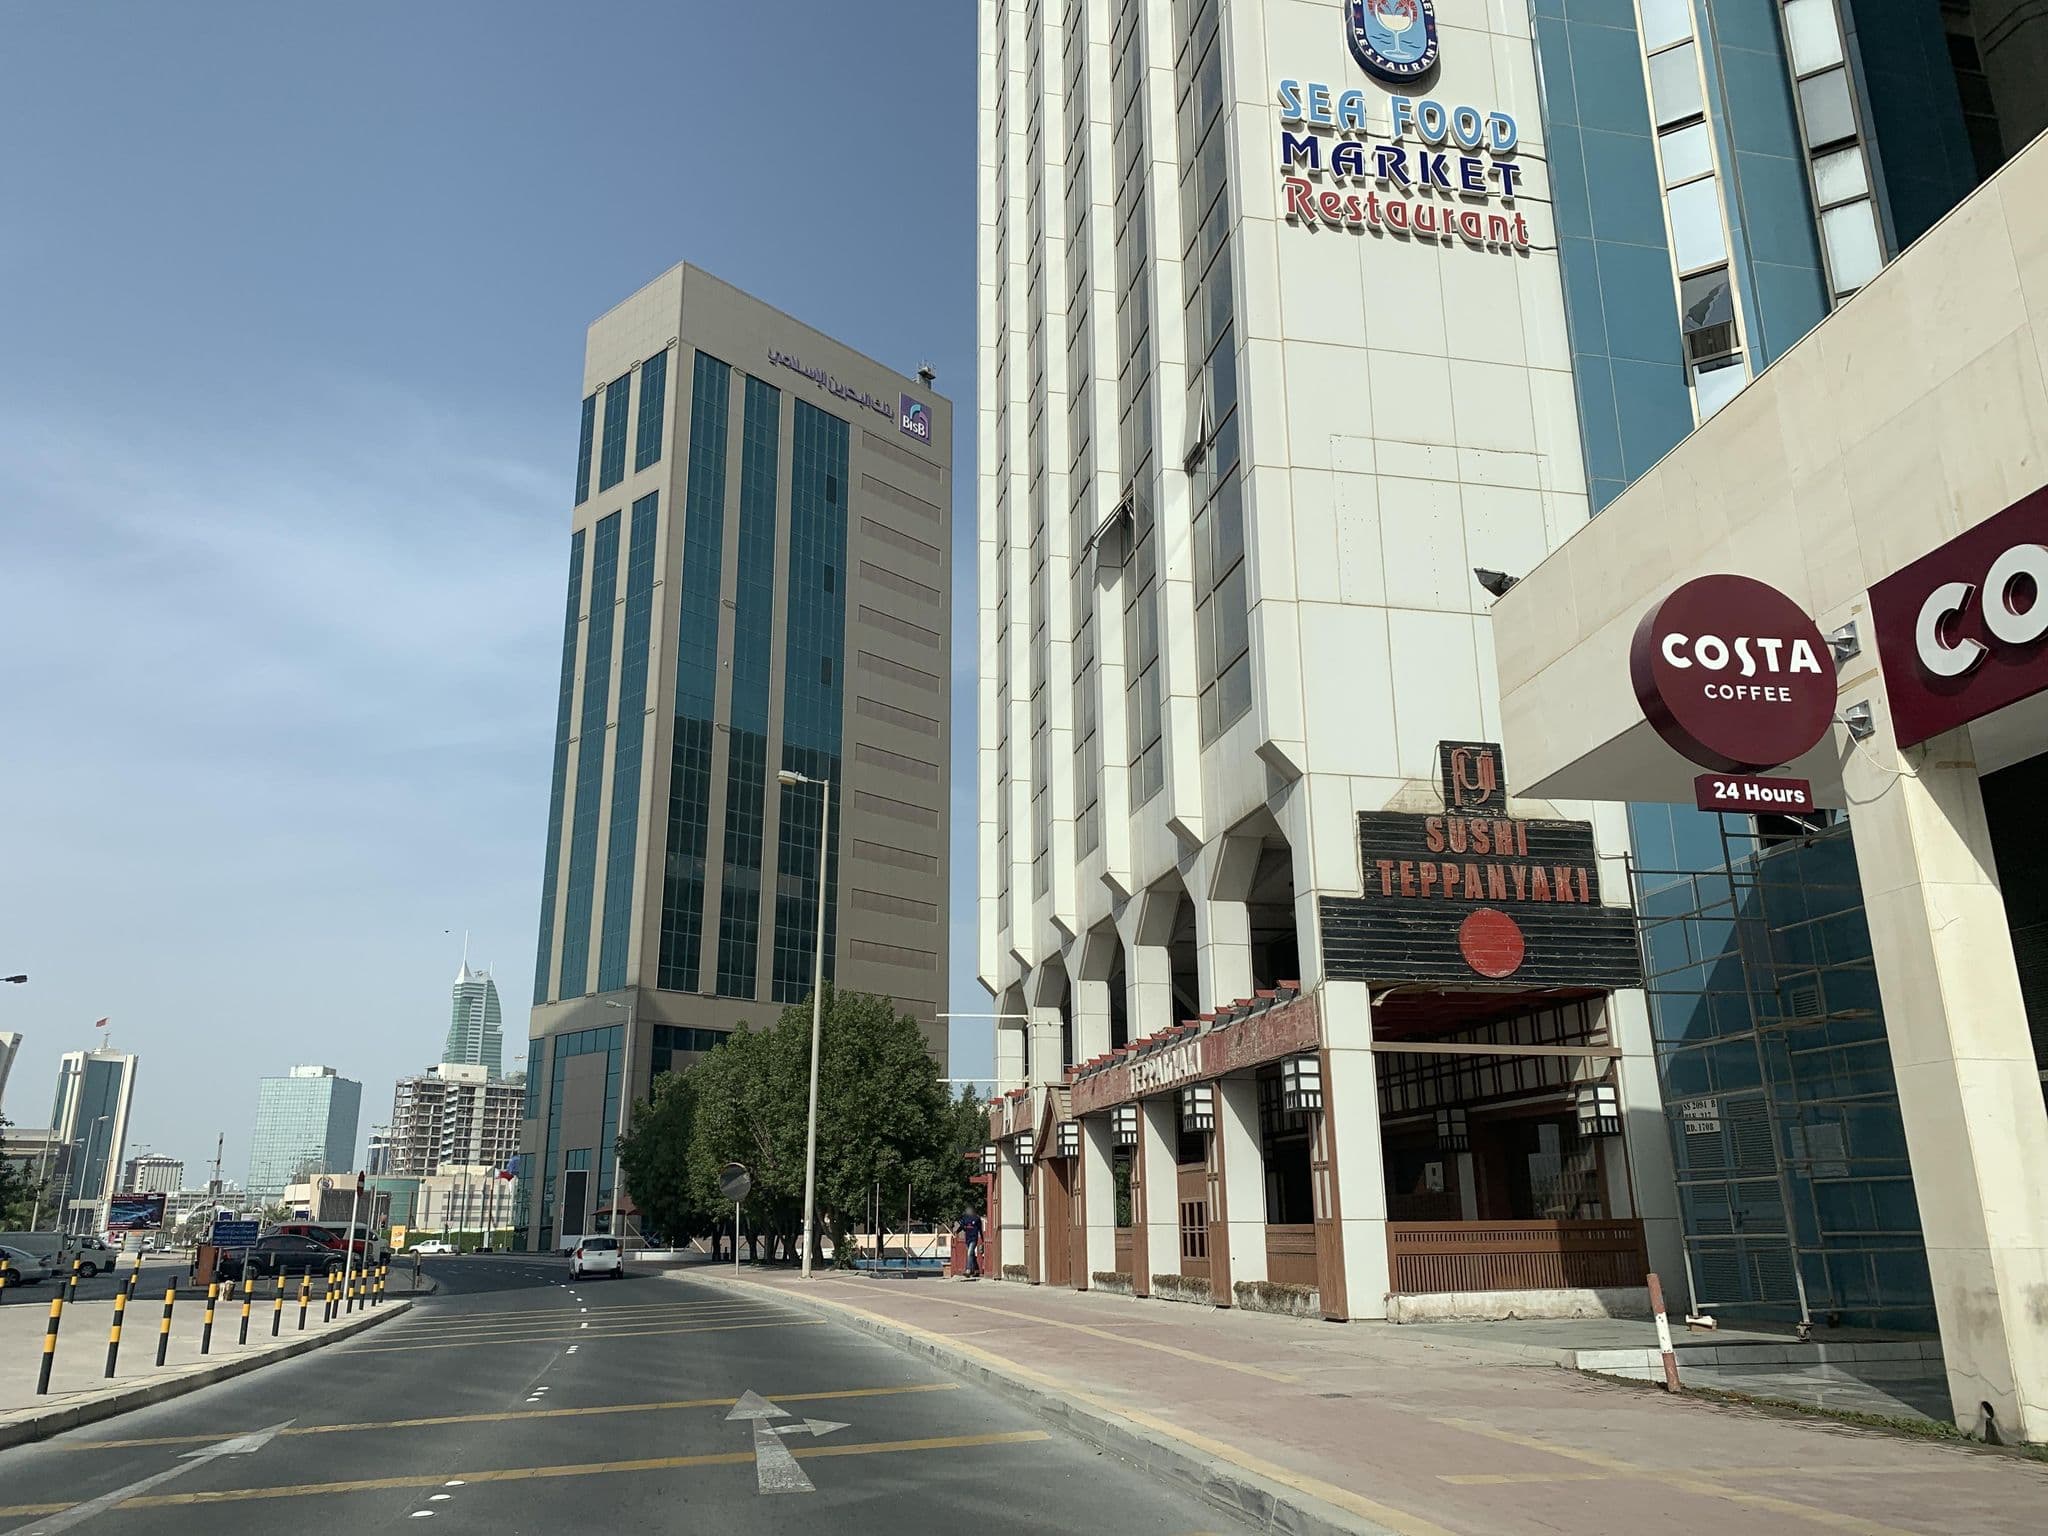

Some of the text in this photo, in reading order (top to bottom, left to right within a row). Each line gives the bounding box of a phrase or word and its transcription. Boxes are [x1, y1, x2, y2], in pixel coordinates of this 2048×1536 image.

[1355, 27, 1437, 72] RESTAURANT
[1278, 79, 1519, 152] SEA FOOD
[1281, 131, 1521, 198] MARKET
[1285, 177, 1529, 247] Restaurant
[902, 414, 926, 437] BisB
[1661, 632, 1823, 677] COSTA
[1704, 684, 1793, 702] COFFEE
[1713, 781, 1806, 804] 24 Hours
[1425, 816, 1529, 857] SUSHI
[1376, 859, 1590, 904] TEPPANYAKI
